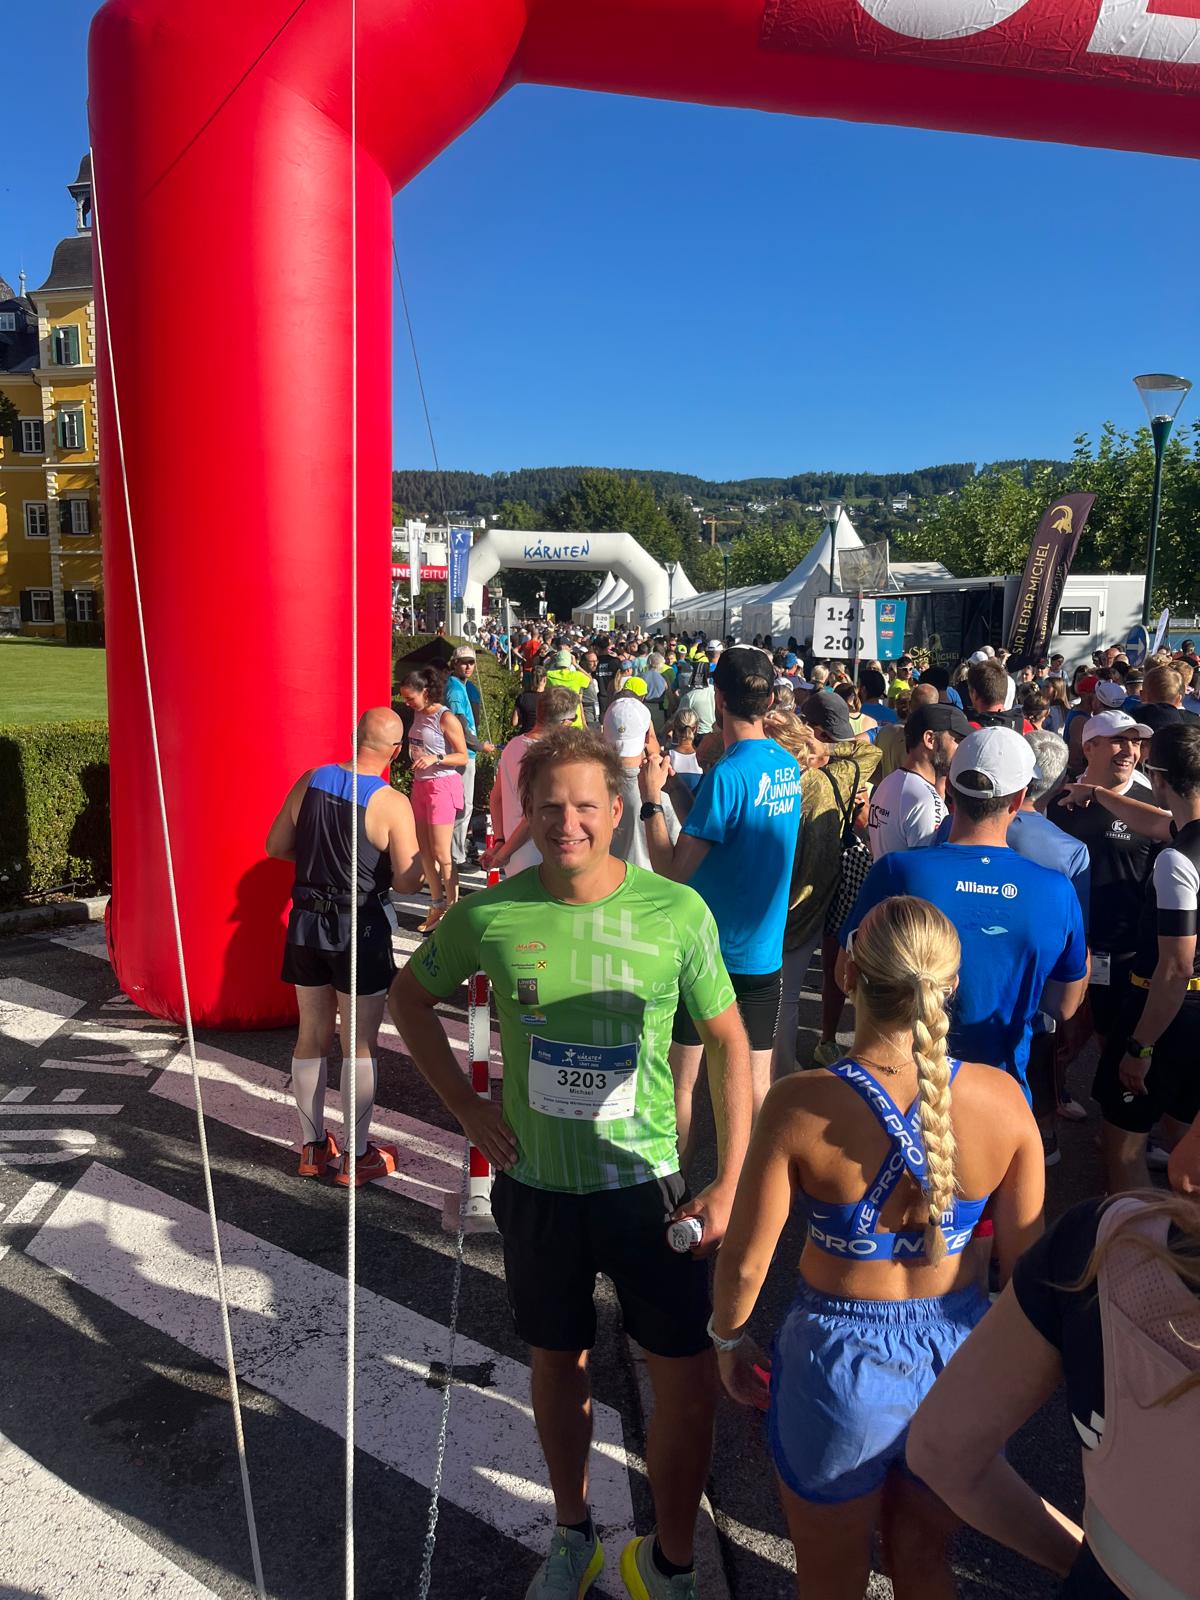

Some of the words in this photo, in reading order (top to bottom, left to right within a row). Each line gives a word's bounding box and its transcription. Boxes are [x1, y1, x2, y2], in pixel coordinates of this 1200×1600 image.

[524, 538, 590, 560] KÄRNTEN
[1028, 543, 1051, 593] MICHEL
[827, 607, 865, 622] 1:41
[1018, 593, 1037, 634] LEDER
[824, 635, 865, 651] 2:00
[1012, 634, 1027, 656] SIR
[774, 767, 796, 783] FLEX
[762, 797, 795, 817] TEAM
[955, 880, 999, 895] Allianz
[557, 1069, 607, 1089] 3203
[569, 1088, 594, 1096] Michael
[837, 1064, 892, 1113] NIKE
[884, 1113, 925, 1166] PRO
[869, 1152, 905, 1205] PRO
[811, 1226, 878, 1256] PRO
